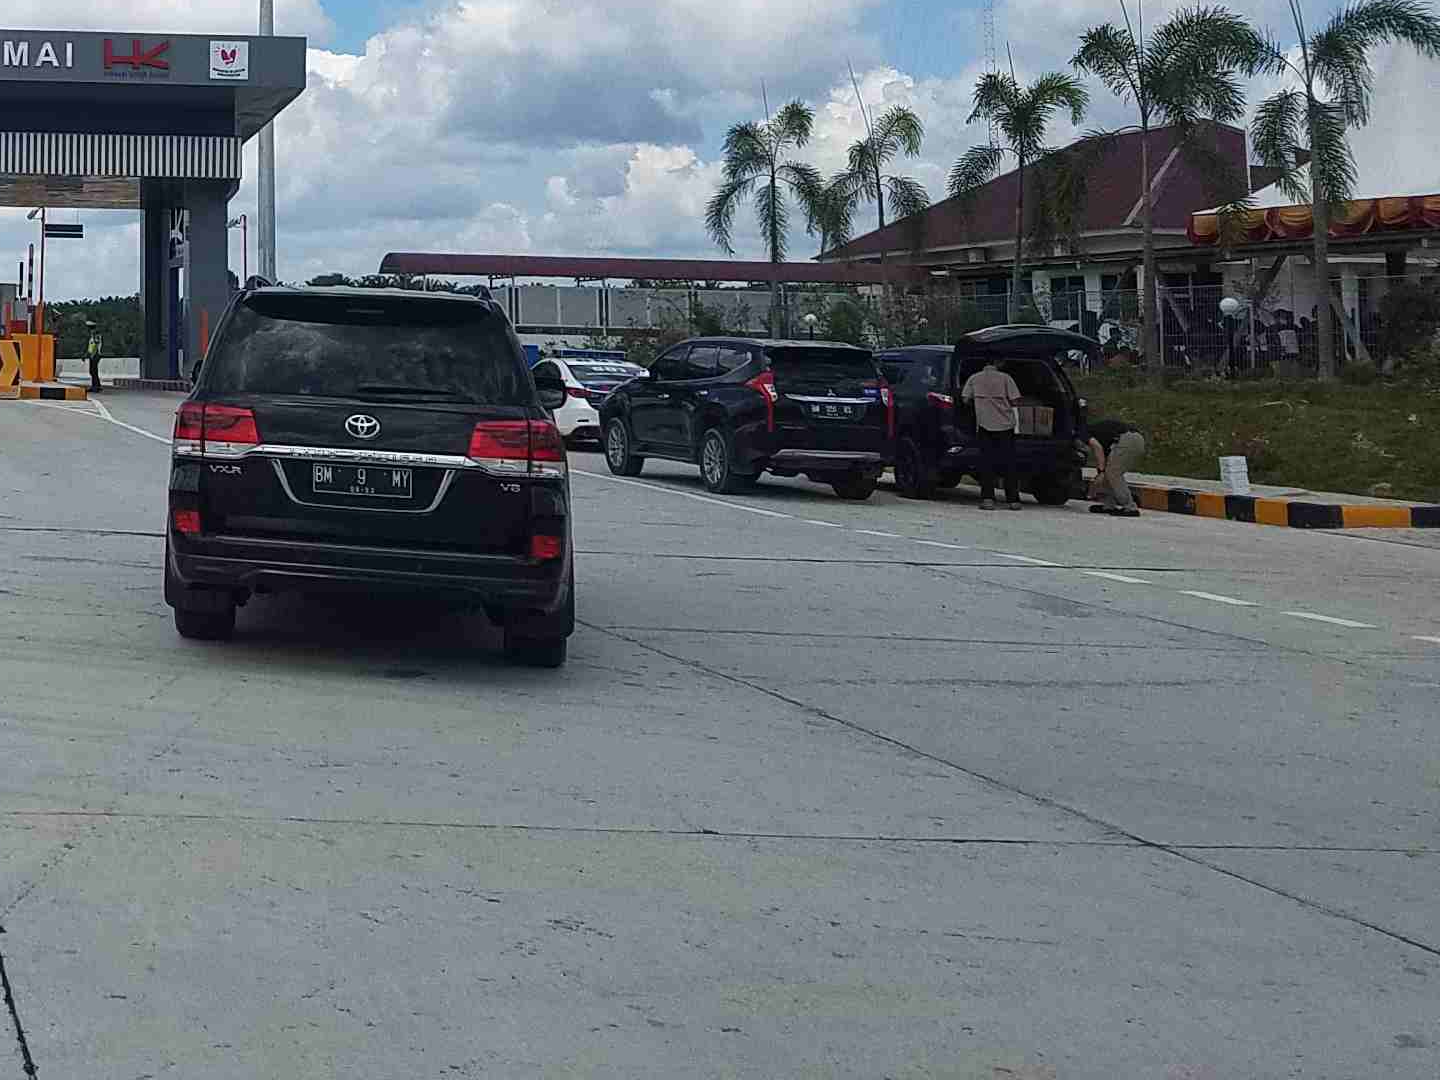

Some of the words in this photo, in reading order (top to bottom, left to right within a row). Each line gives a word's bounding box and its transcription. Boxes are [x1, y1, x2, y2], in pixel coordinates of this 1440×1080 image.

[316, 466, 332, 483] BM
[358, 469, 366, 485] 9
[392, 470, 409, 488] MY
